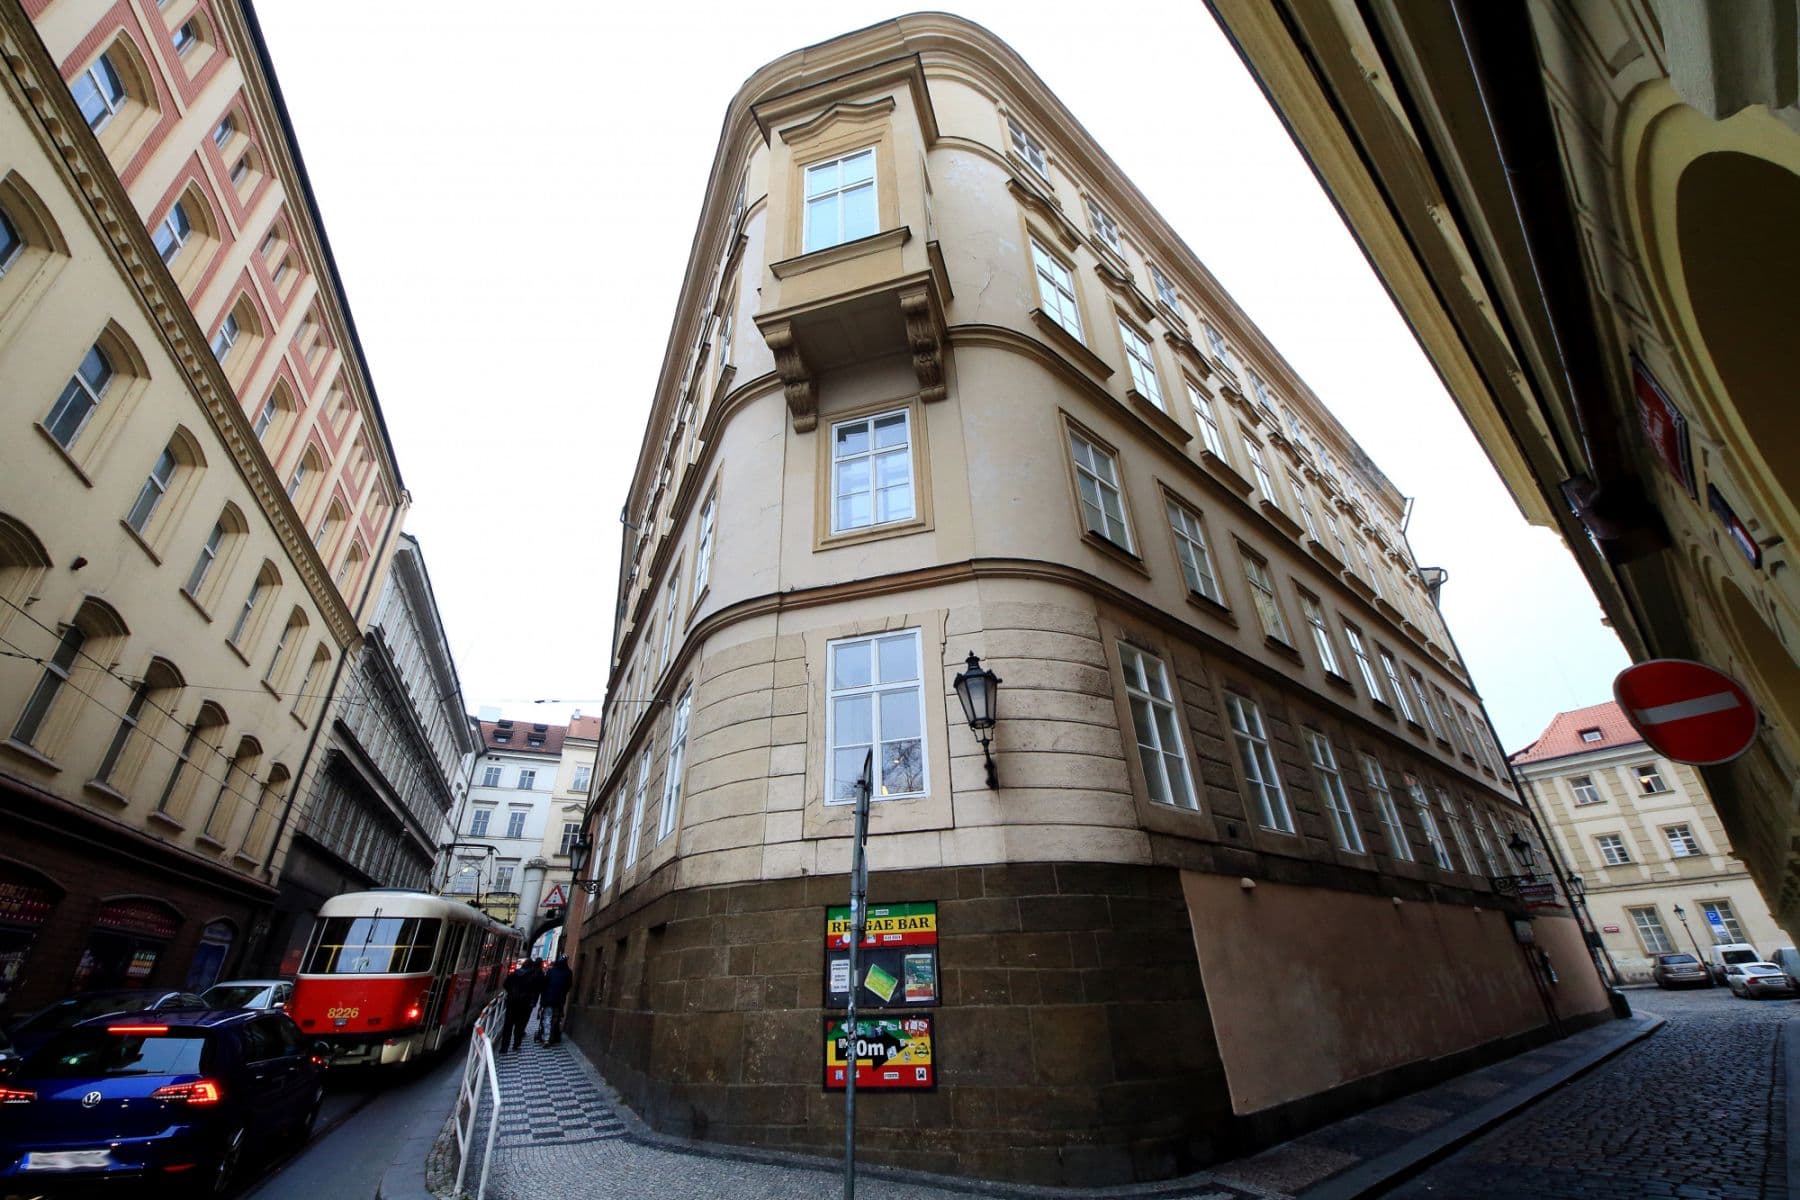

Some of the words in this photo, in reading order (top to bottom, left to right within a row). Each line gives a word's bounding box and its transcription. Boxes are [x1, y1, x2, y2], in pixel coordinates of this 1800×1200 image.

[832, 919, 893, 932] REGAE
[898, 917, 930, 930] BAR
[327, 1007, 359, 1019] 8226
[845, 1039, 885, 1057] 0m
